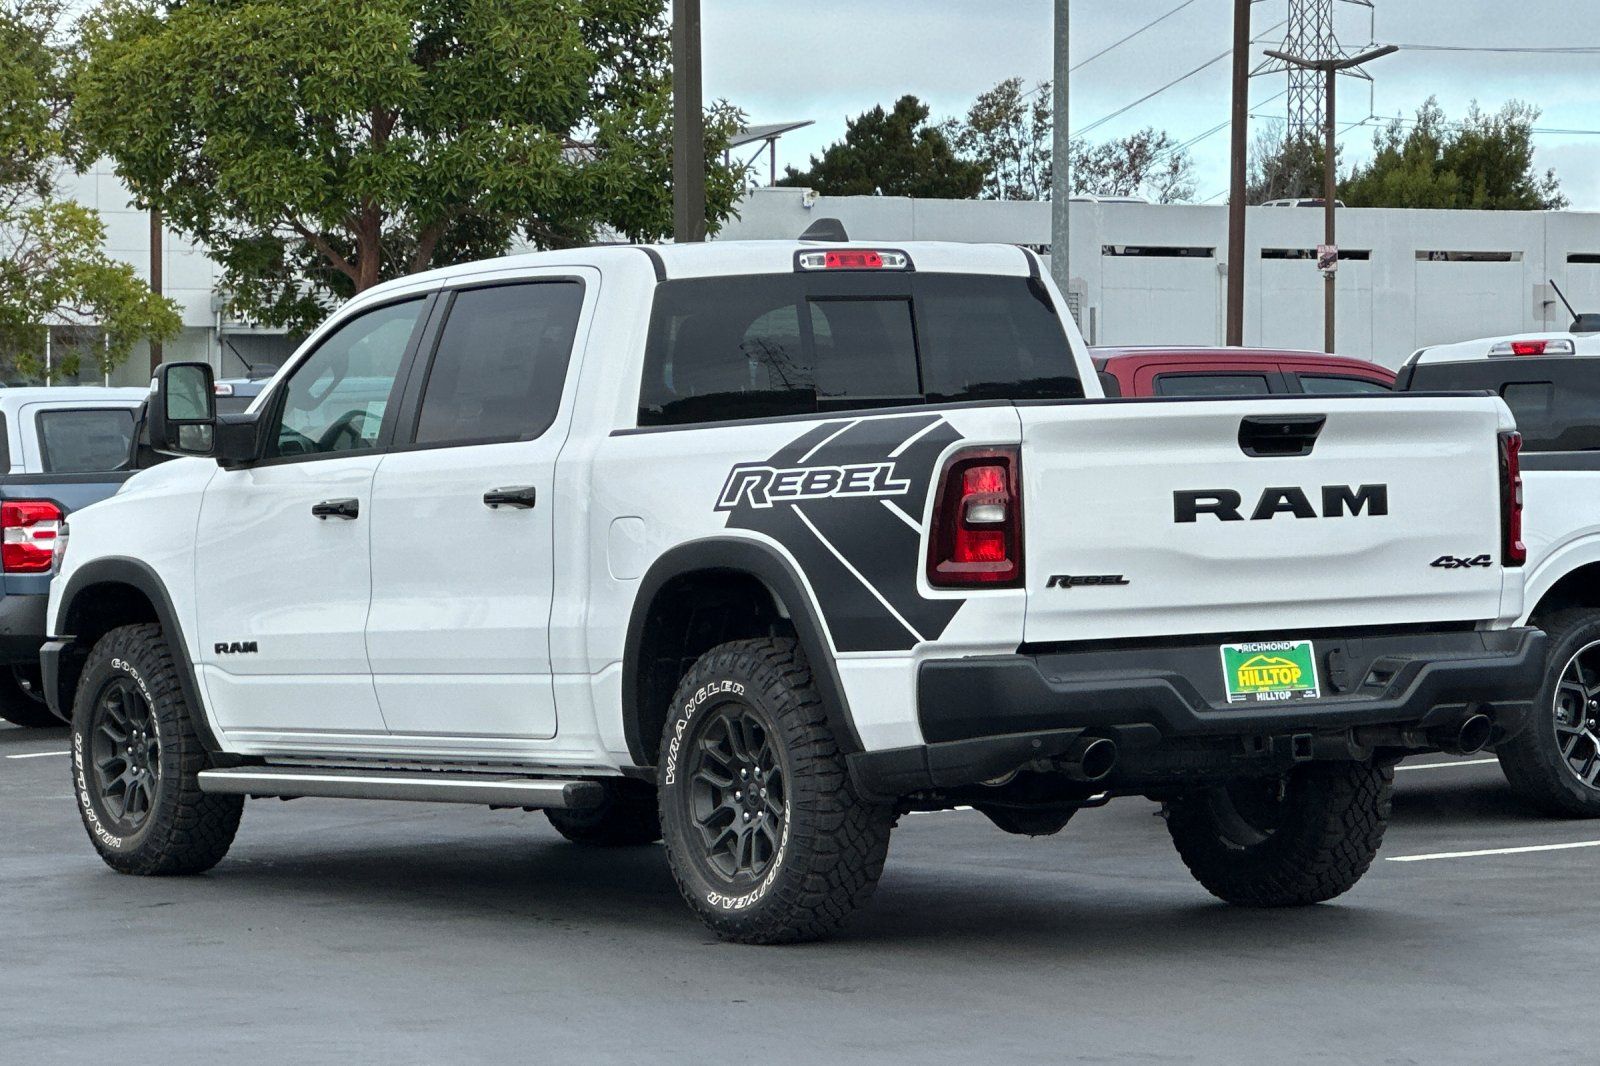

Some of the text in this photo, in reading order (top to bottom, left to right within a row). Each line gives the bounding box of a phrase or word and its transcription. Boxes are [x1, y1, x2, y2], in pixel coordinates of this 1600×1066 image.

[717, 462, 911, 510] REBEL
[1173, 483, 1388, 522] RAM
[1429, 554, 1493, 569] 4x4
[1045, 574, 1130, 589] REBEL
[214, 641, 258, 654] RAM
[1242, 642, 1290, 652] RICHMOND
[1237, 668, 1301, 687] HILLTOP
[1256, 691, 1291, 701] HILLTOP
[665, 680, 745, 785] WRANGLER
[75, 732, 122, 848] WRANGLER
[706, 799, 791, 909] GOODYEAR
